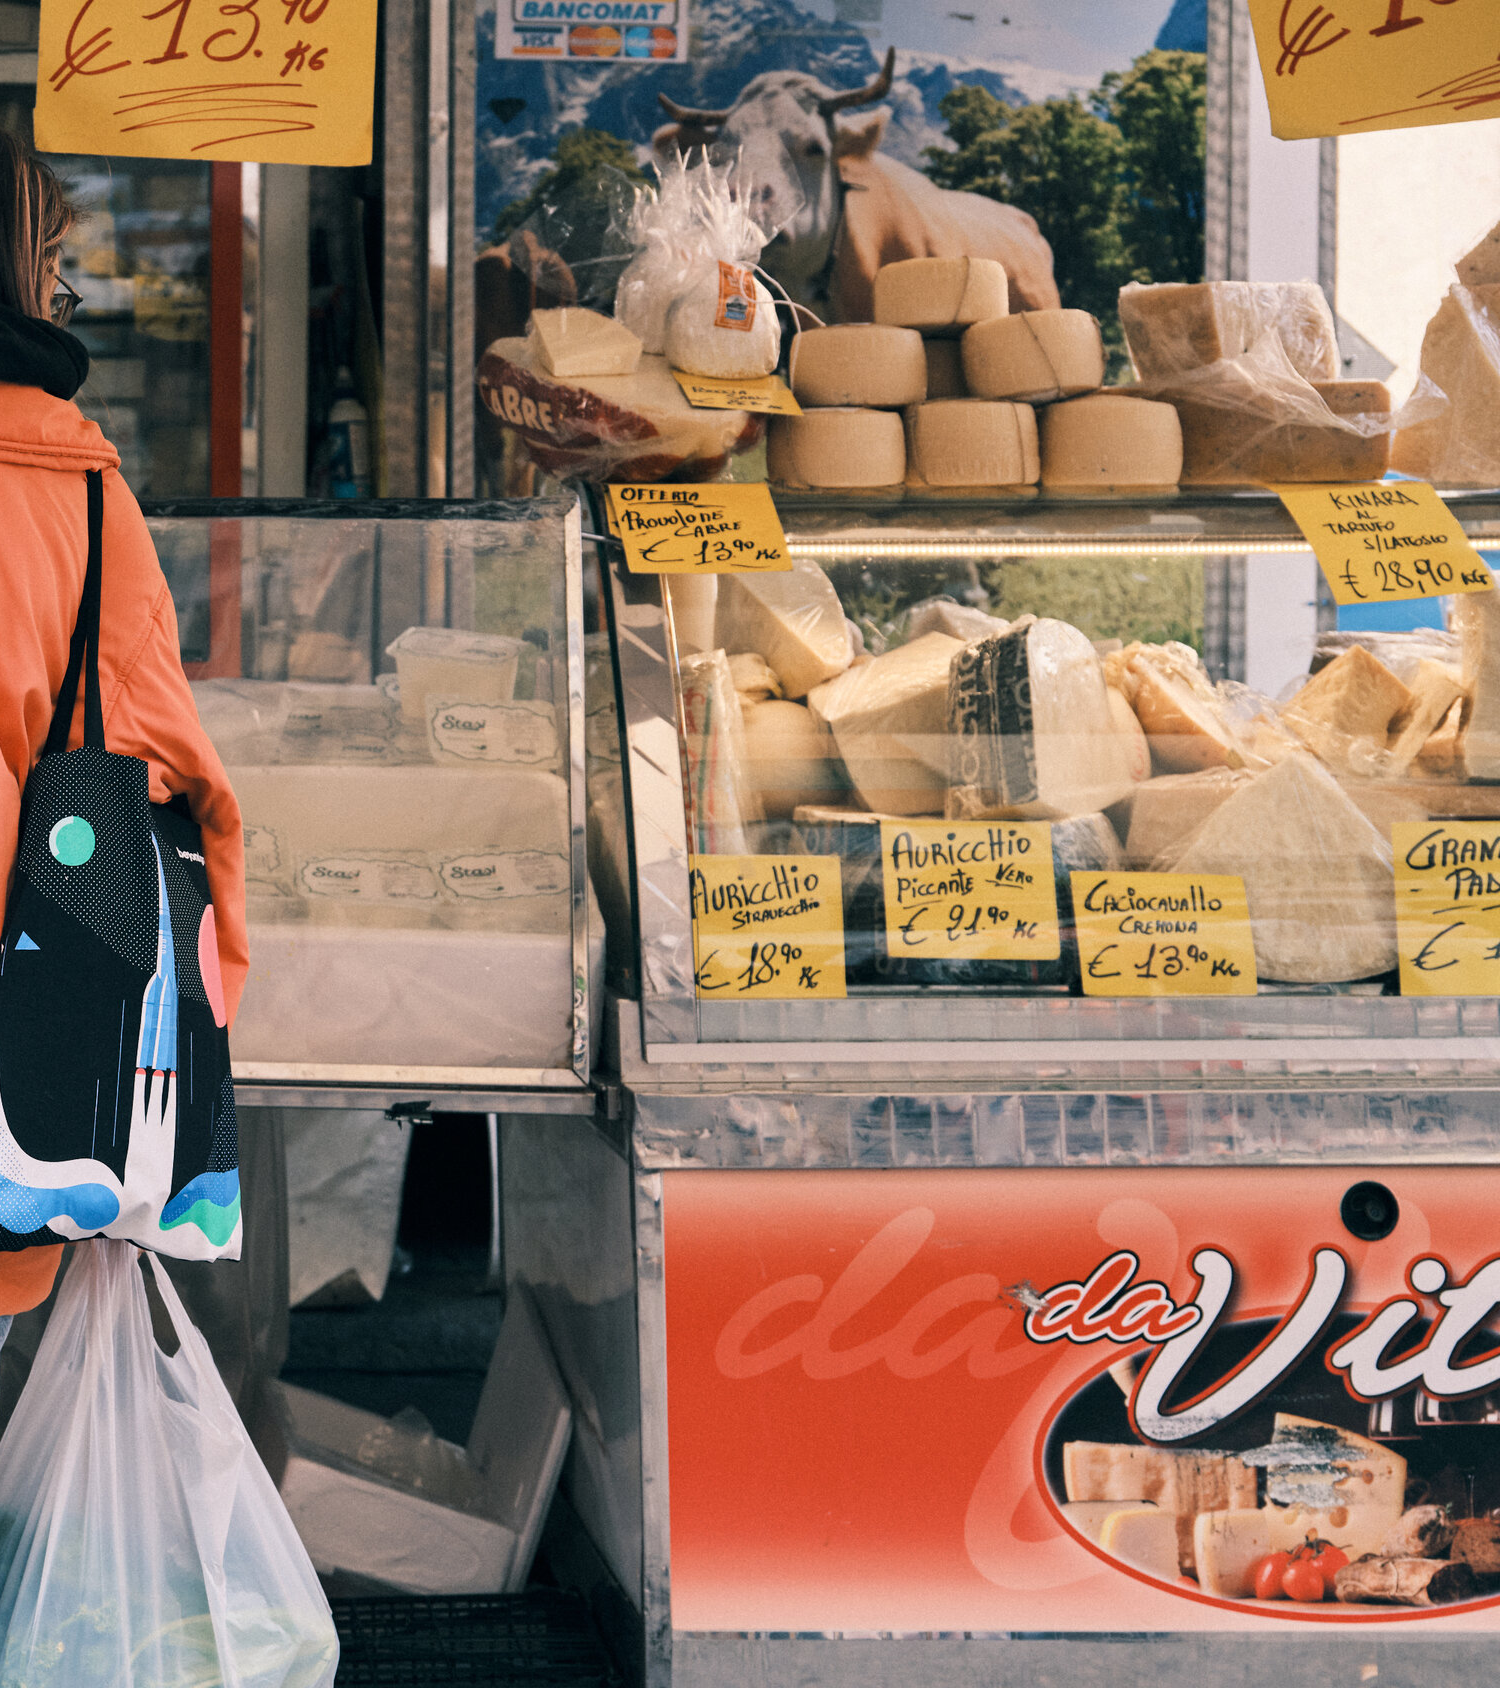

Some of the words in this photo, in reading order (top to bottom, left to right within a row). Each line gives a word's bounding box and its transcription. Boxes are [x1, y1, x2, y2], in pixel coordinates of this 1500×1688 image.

[522, 2, 665, 20] BANCOMAT
[480, 376, 556, 434] ABRE
[621, 488, 699, 501] OFFERTA
[1329, 490, 1419, 510] KINARA
[1323, 521, 1394, 534] TARTUFO
[1356, 510, 1378, 520] AL
[639, 539, 684, 562] €
[1339, 558, 1368, 598] €
[1374, 559, 1453, 594] 28,90
[899, 907, 928, 945] €
[1119, 916, 1198, 934] CREMONA
[1410, 921, 1459, 971] €
[695, 949, 731, 990] €
[1088, 944, 1121, 977] €
[1025, 1250, 1202, 1343] da
